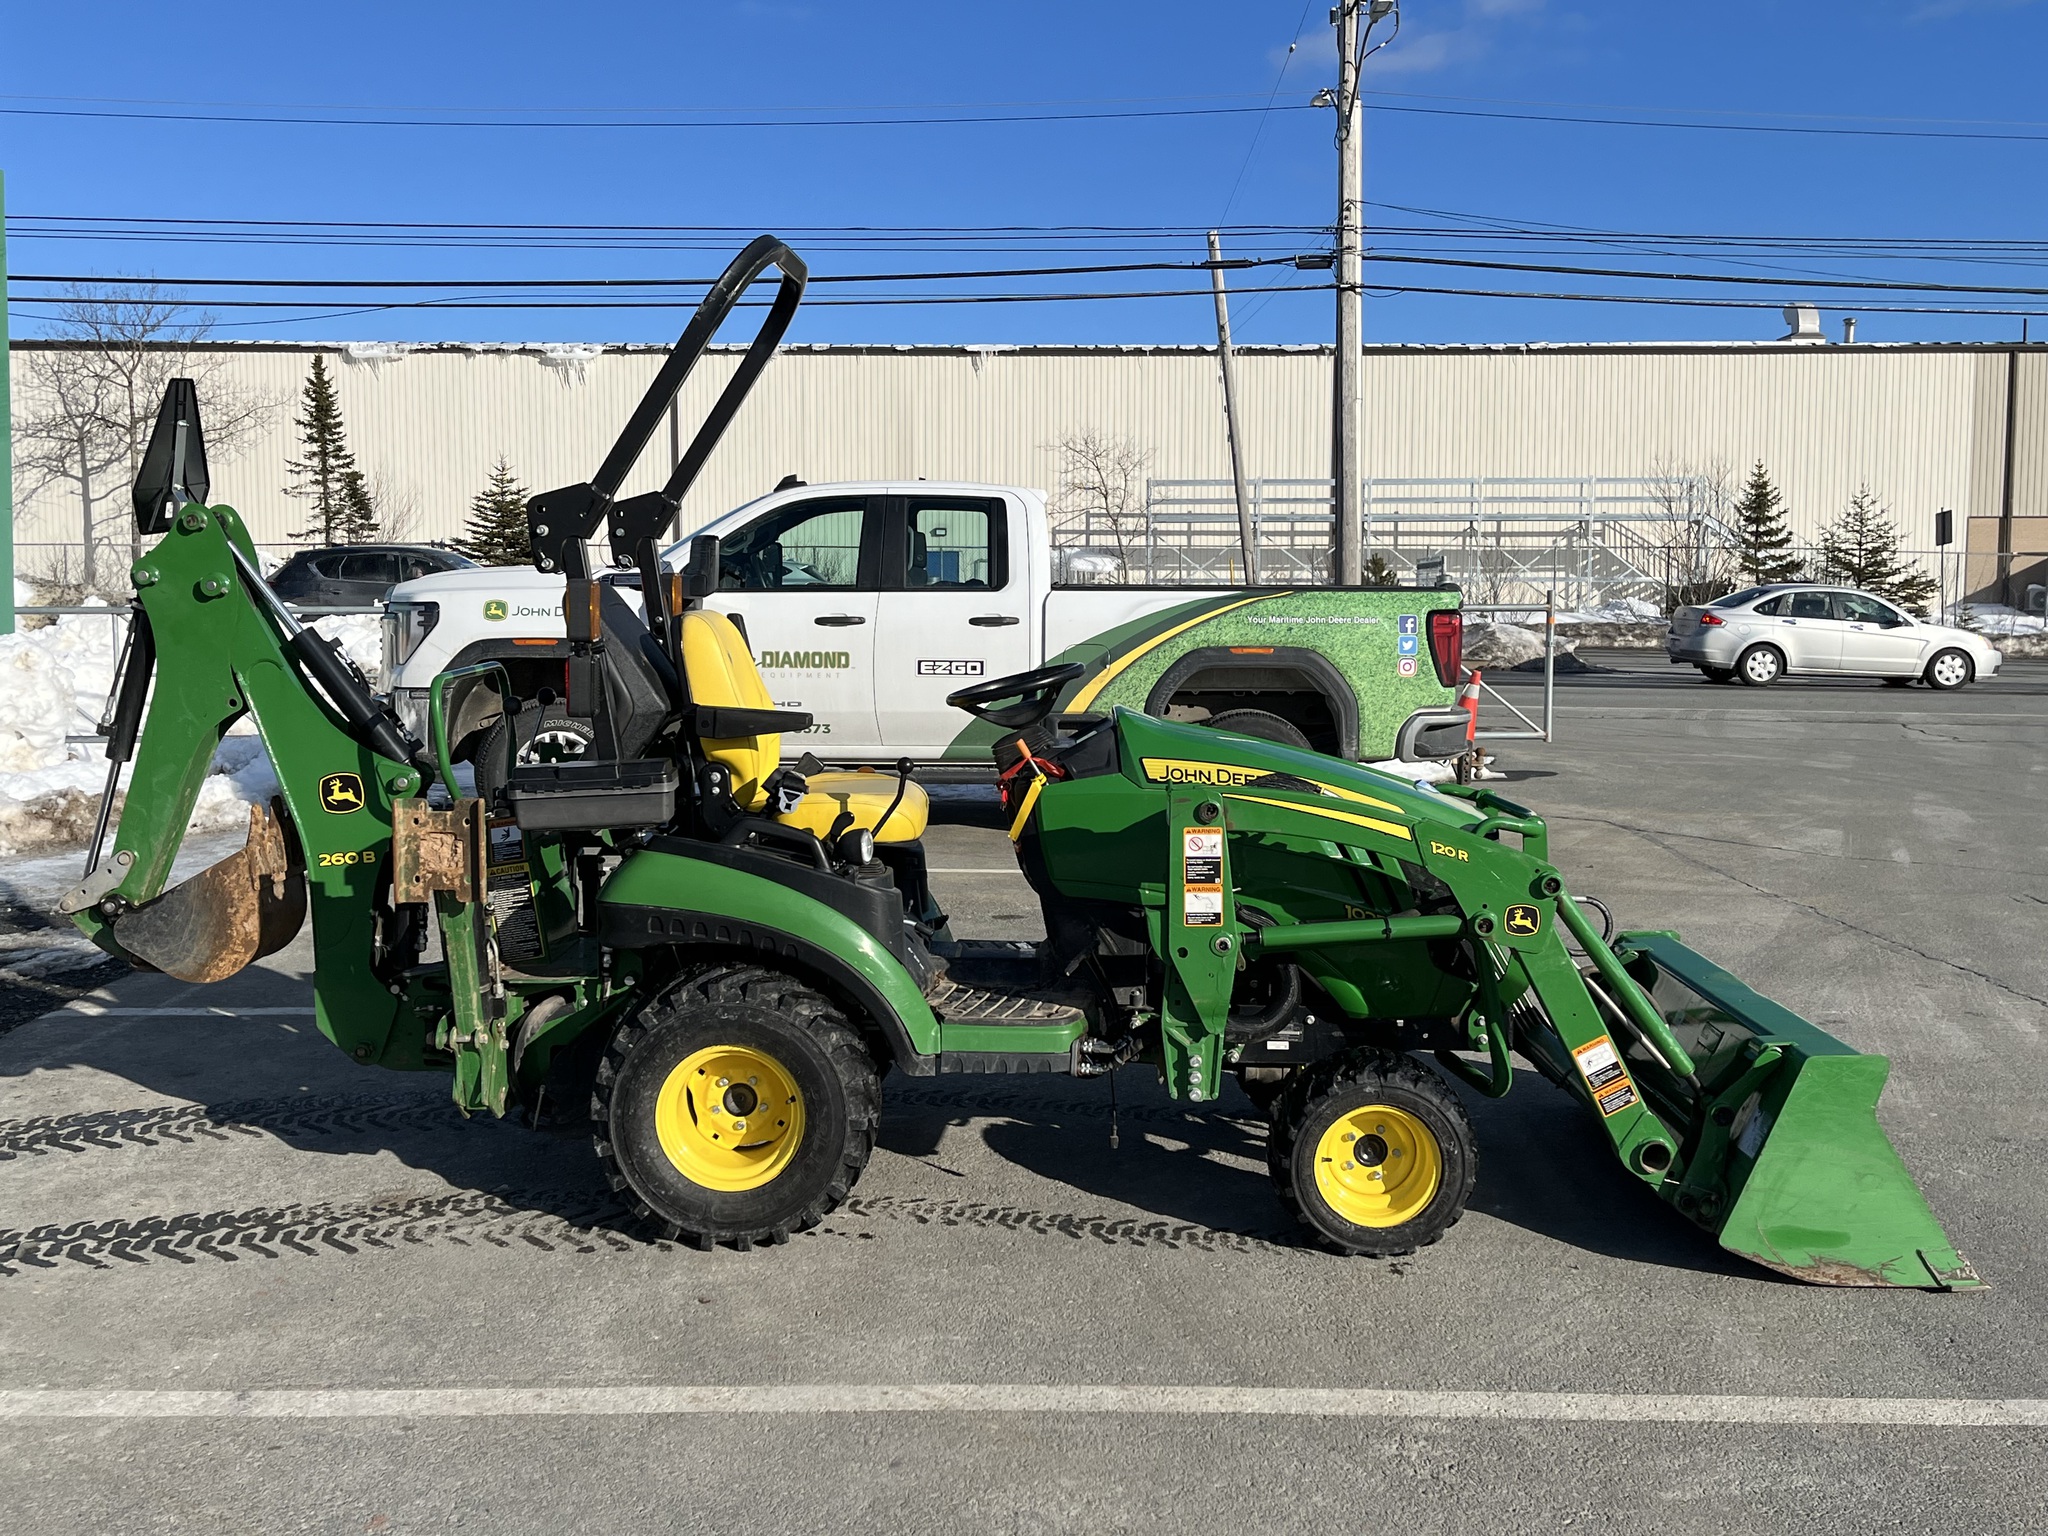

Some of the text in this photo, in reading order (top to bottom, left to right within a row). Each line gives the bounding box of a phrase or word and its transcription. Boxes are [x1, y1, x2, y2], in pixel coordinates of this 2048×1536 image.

[512, 605, 550, 616] JOHN
[1247, 616, 1379, 624] Your Maritime John Deere Dealer
[761, 651, 850, 669] DIAMOND
[919, 660, 982, 675] EZGO
[1159, 765, 1211, 783] JOHN
[318, 850, 377, 867] 260 B
[1430, 841, 1469, 863] 120 R
[496, 864, 525, 875] CAUTION
